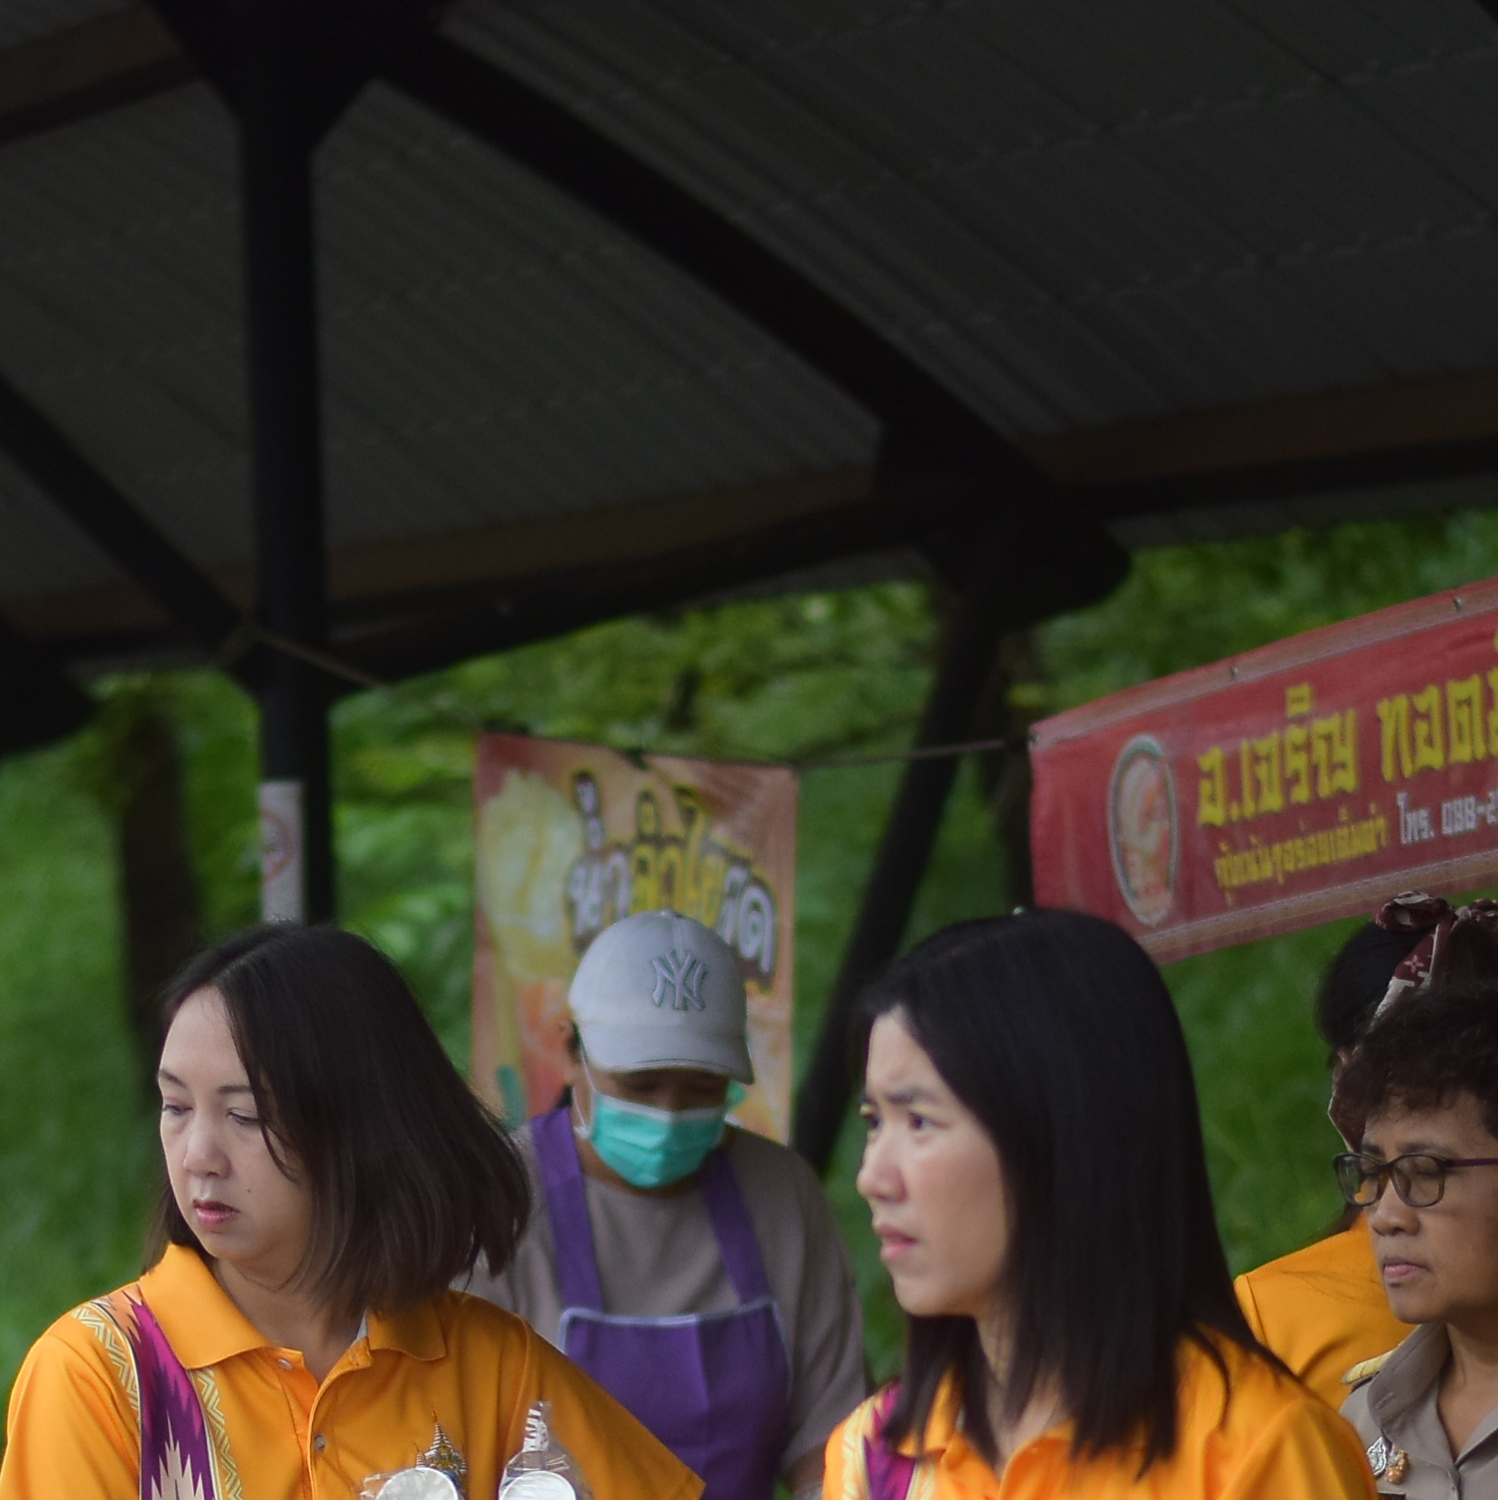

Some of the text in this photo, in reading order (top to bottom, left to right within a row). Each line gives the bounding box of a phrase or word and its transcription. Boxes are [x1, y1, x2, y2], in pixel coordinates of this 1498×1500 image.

[1194, 683, 1359, 829] อ.เจริญ
[1398, 793, 1435, 845] โทร.
[650, 947, 707, 1013] NY
